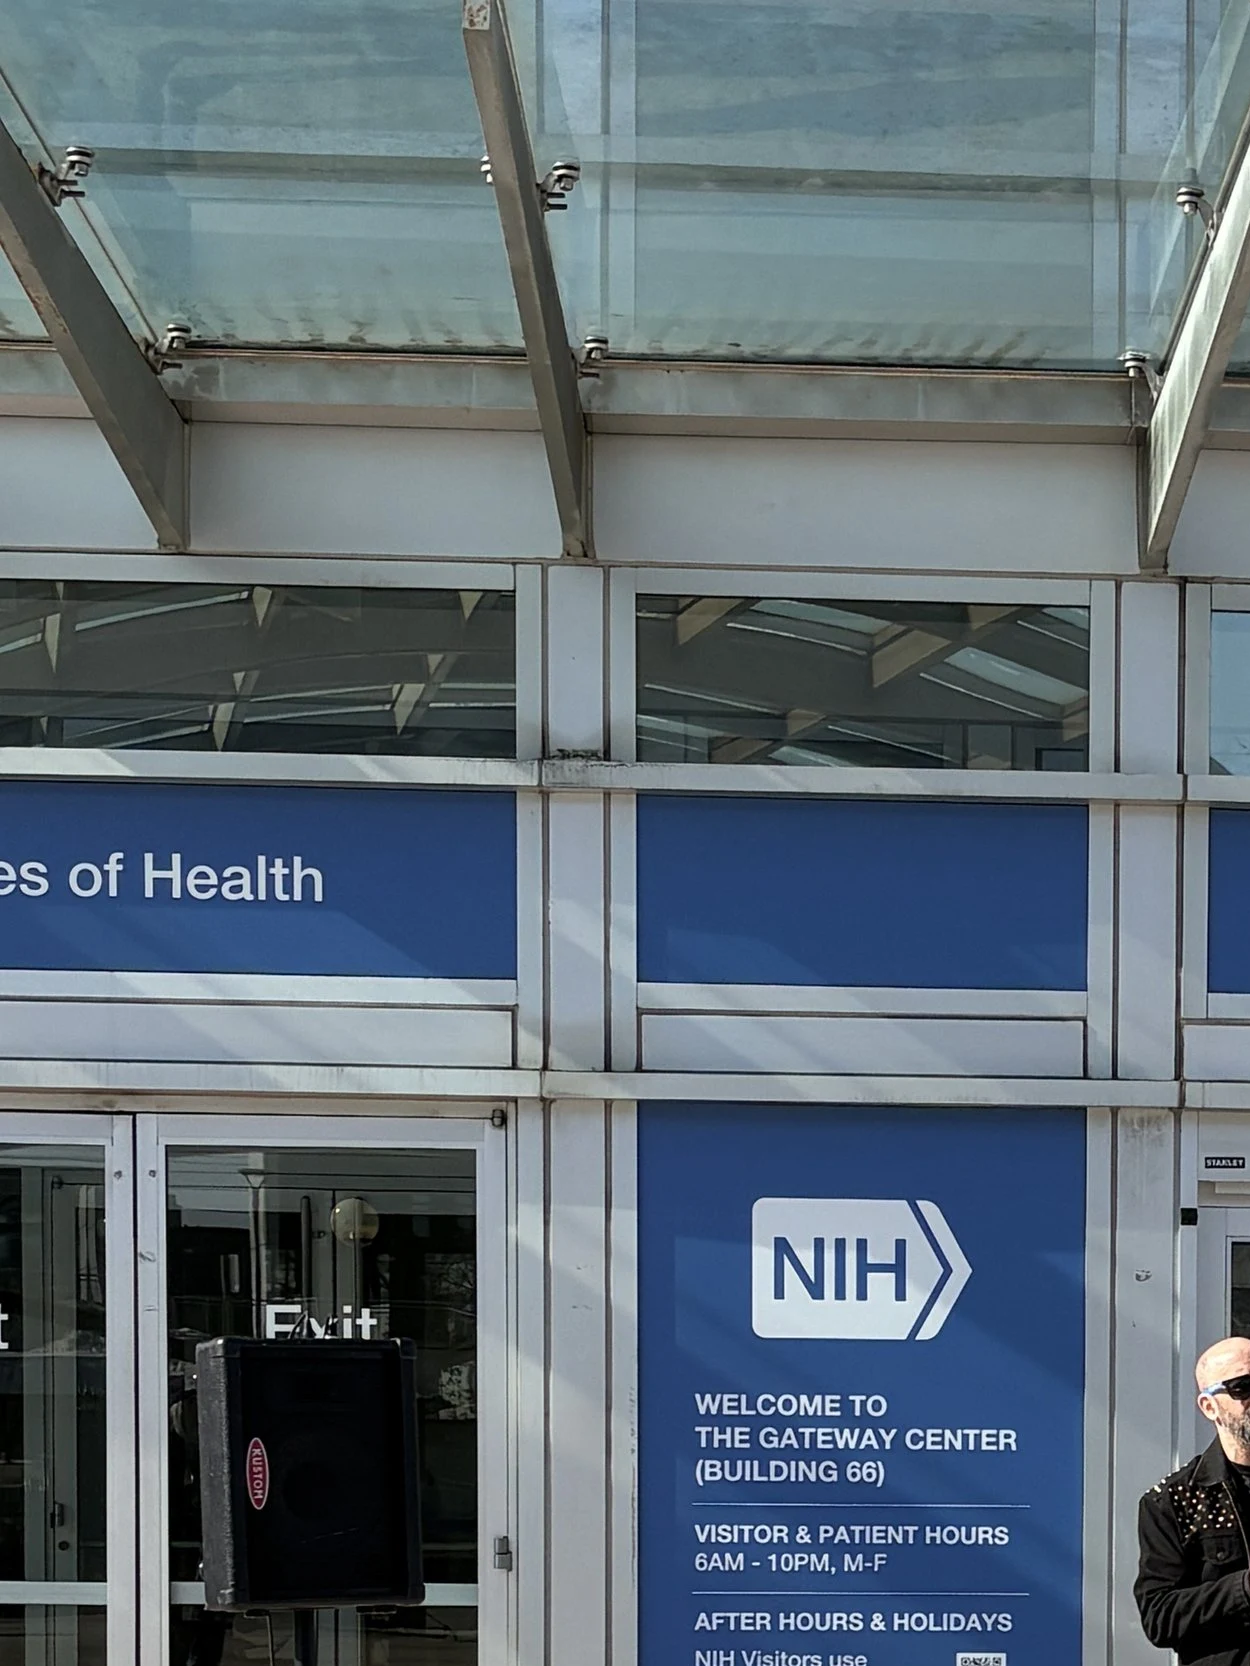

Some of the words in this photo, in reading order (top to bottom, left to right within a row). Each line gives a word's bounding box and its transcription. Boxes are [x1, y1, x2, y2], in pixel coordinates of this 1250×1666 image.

[69, 852, 124, 897] of
[144, 852, 323, 902] Health
[773, 1236, 907, 1302] NIH
[694, 1393, 841, 1417] WELCOME
[848, 1395, 887, 1417] TO
[694, 1426, 750, 1448] THE
[758, 1427, 897, 1449] GATEWAY
[905, 1429, 1017, 1451] CENTER
[695, 1459, 838, 1487] (BUILDING
[846, 1460, 885, 1487] 66)
[694, 1524, 789, 1543] VISITOR
[796, 1525, 811, 1543] &
[819, 1525, 918, 1544] PATIENT
[925, 1526, 1009, 1545] HOURS
[694, 1553, 744, 1571] 6AM
[767, 1553, 836, 1575] 10PM,
[844, 1554, 887, 1572] M-F
[694, 1612, 771, 1631] AFTER
[779, 1613, 863, 1631] HOURS
[870, 1613, 886, 1632] &
[893, 1613, 1012, 1632] HOLIDAYS
